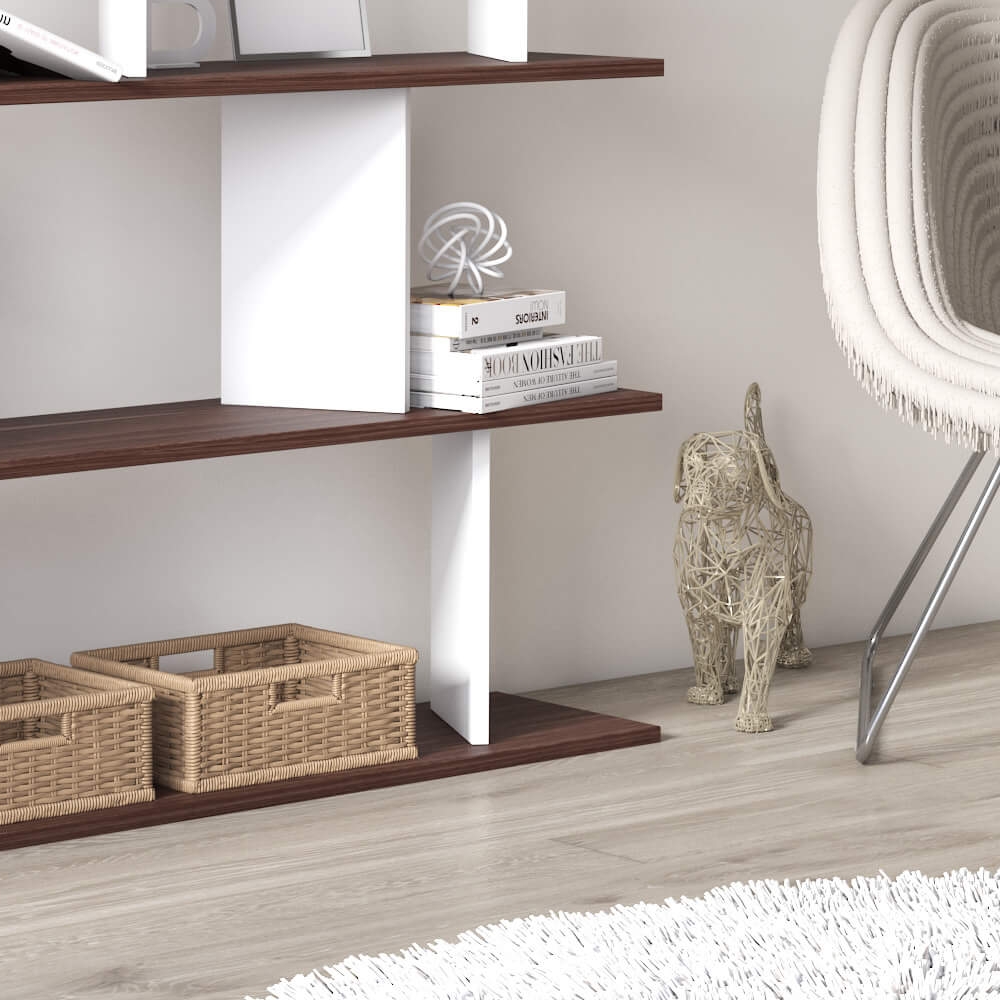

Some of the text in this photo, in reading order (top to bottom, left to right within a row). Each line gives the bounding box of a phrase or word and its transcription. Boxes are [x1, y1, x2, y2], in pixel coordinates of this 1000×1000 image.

[471, 316, 479, 326] 2
[515, 310, 549, 325] INTERIORS
[576, 341, 601, 363] THE
[522, 344, 574, 372] FASHION
[546, 373, 568, 384] ALLURE
[568, 369, 581, 380] THE
[512, 378, 537, 389] WOMEN
[537, 376, 546, 385] OF
[546, 388, 568, 399] ALLURE
[568, 385, 581, 395] THE
[523, 393, 537, 402] MEN
